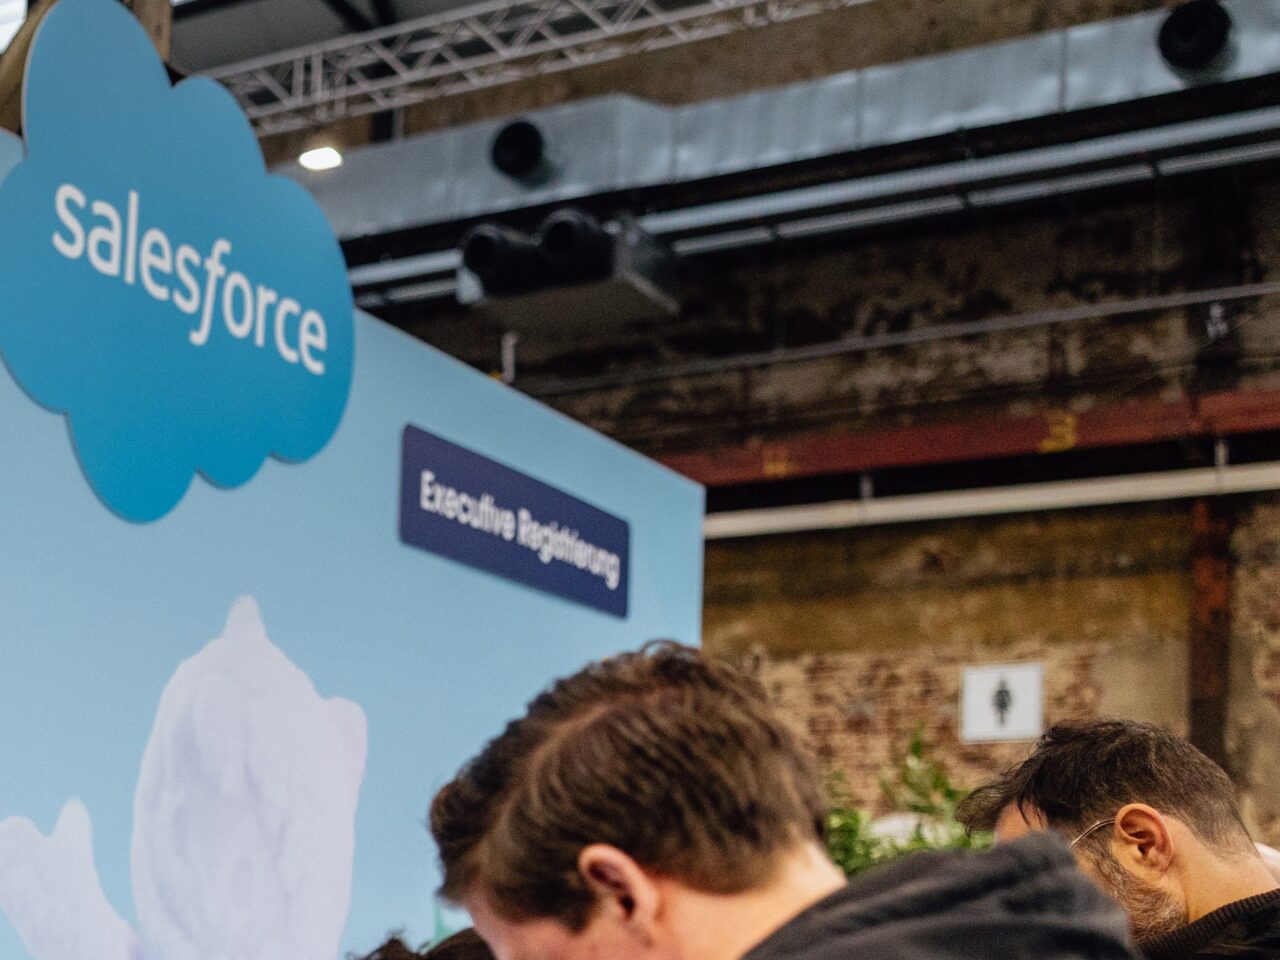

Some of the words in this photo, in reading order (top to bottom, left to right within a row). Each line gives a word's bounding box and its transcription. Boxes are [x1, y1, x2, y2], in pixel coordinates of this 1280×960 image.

[51, 183, 328, 376] salesforce
[420, 469, 516, 541] Executive
[517, 507, 621, 591] Registrierung
